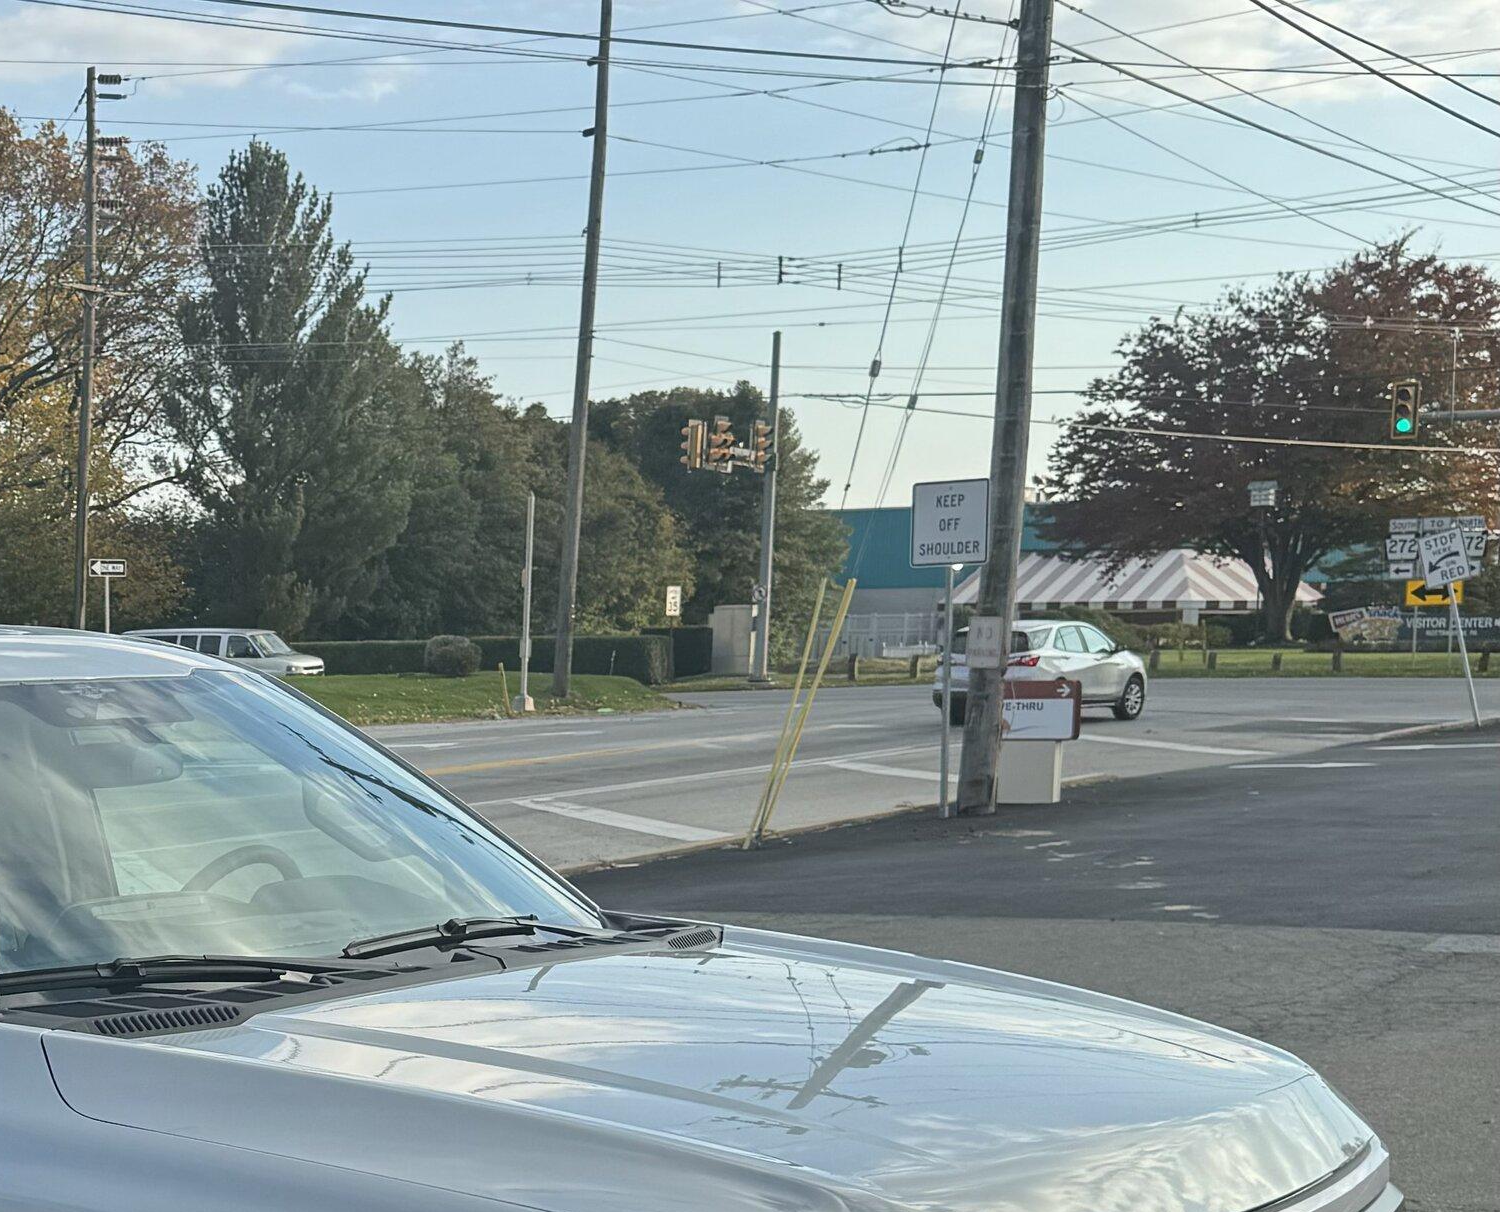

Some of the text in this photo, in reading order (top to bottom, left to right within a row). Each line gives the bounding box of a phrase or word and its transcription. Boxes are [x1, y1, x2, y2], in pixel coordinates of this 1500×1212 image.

[935, 494, 965, 508] KEEP
[938, 518, 961, 532] OFF
[1391, 521, 1417, 530] SOUTH
[1430, 519, 1444, 527] TO
[918, 540, 980, 556] SHOULDER
[1389, 540, 1417, 554] 272
[1424, 533, 1456, 550] STOP
[1465, 536, 1484, 551] 72
[1440, 565, 1465, 580] RED
[1002, 701, 1044, 711] E-THRU
